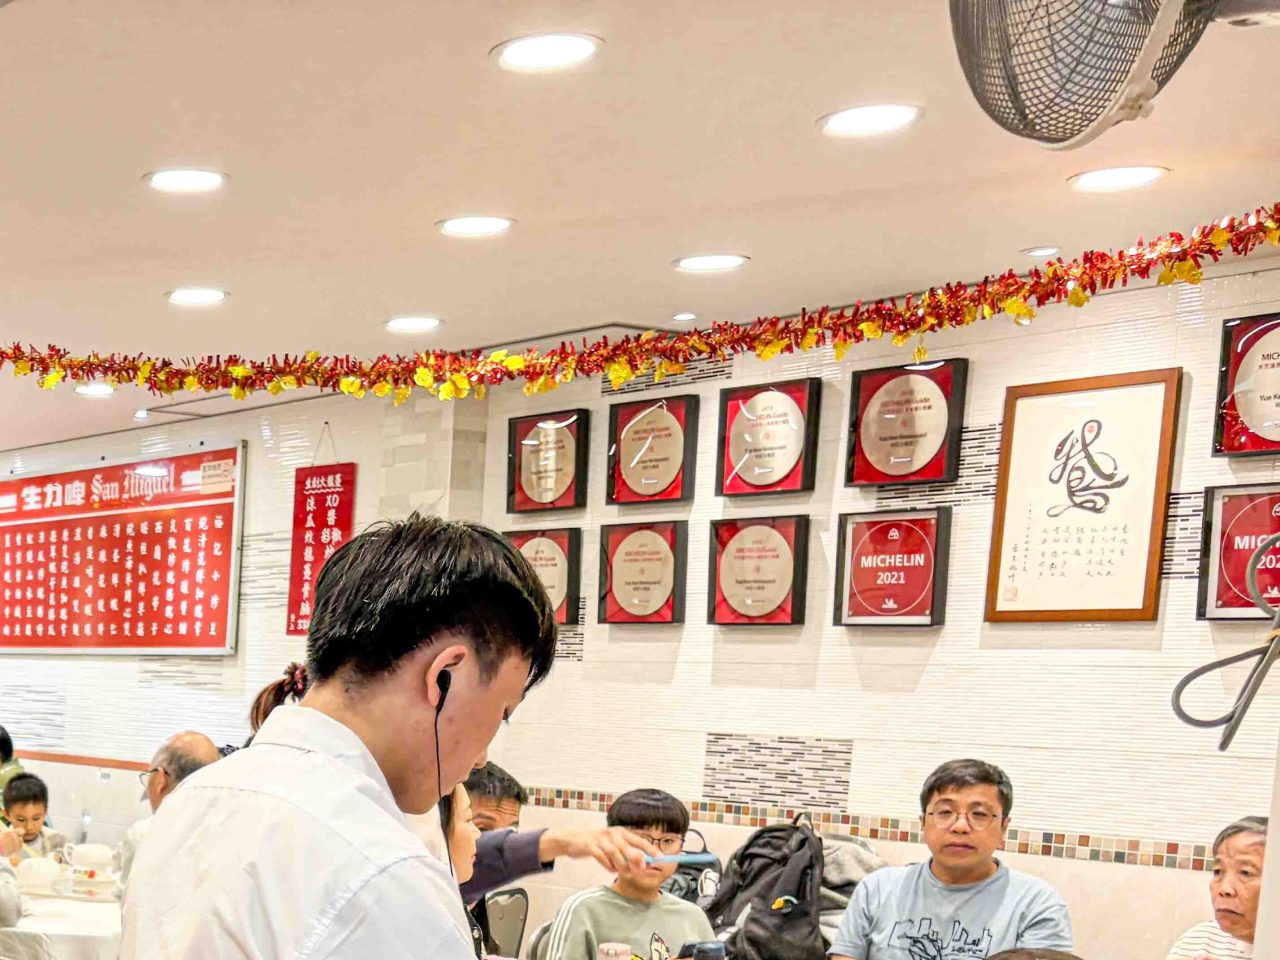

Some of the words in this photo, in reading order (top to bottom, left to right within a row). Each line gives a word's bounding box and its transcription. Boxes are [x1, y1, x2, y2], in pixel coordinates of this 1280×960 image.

[22, 479, 86, 511] 生力啤
[90, 473, 119, 503] San
[861, 554, 925, 568] MICHELIN
[876, 572, 906, 584] 2021
